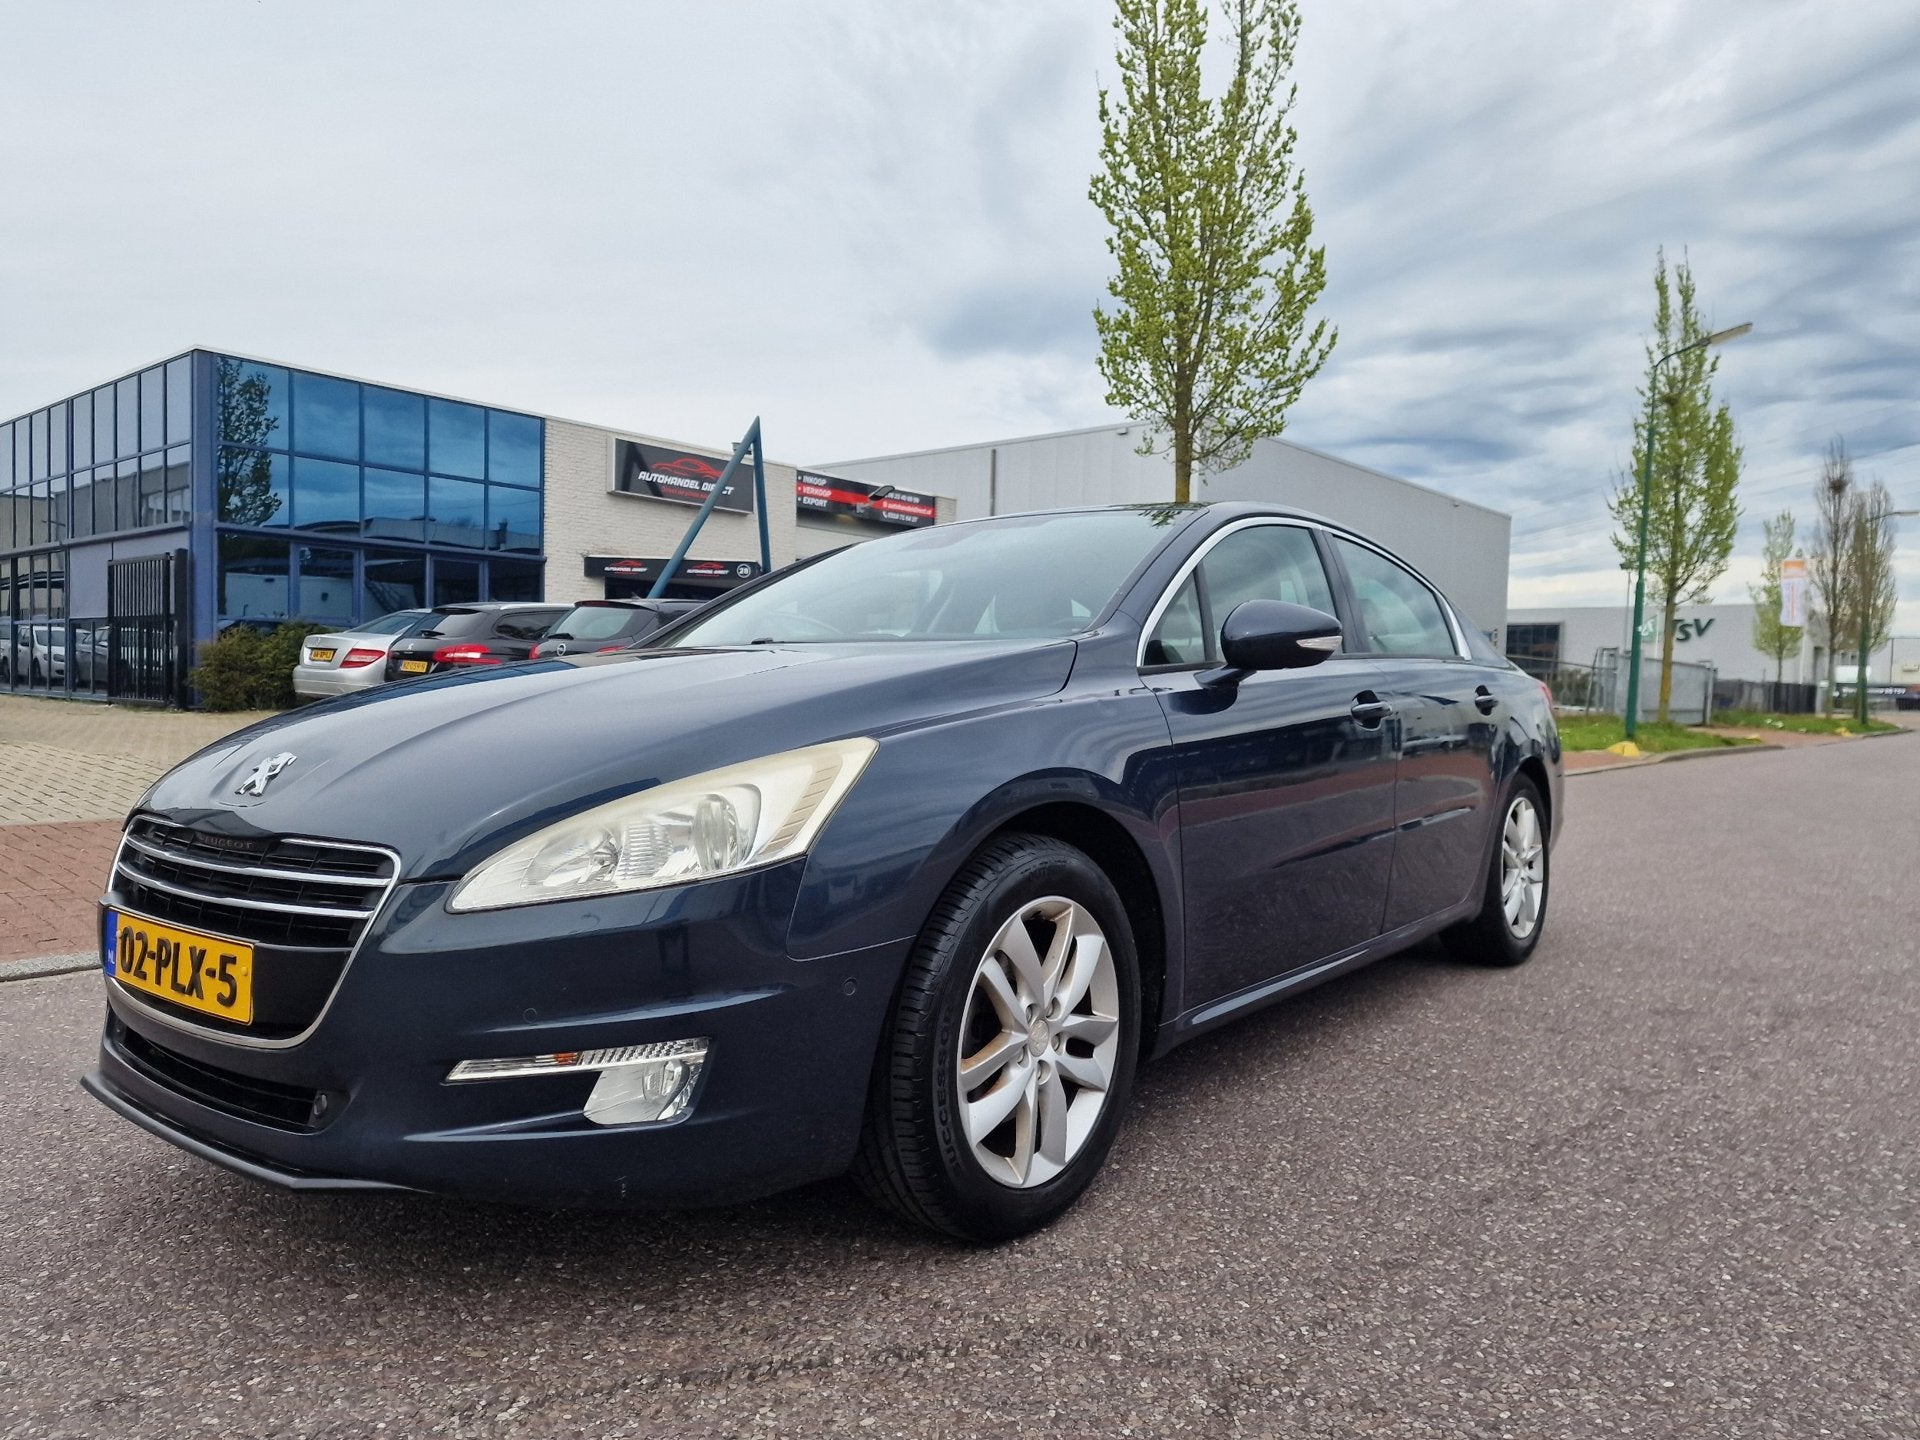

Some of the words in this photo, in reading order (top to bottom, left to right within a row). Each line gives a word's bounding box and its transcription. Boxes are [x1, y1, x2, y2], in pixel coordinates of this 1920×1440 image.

[637, 470, 700, 490] AUTOHANDEL
[701, 482, 735, 496] DIRT
[802, 475, 827, 486] INKOOP
[802, 485, 832, 497] VERKOOP
[802, 496, 828, 508] EXPORT
[739, 567, 749, 575] 28
[199, 833, 254, 849] PEUGEOT
[107, 948, 116, 965] NL
[120, 925, 238, 1008] 02-PLX-5
